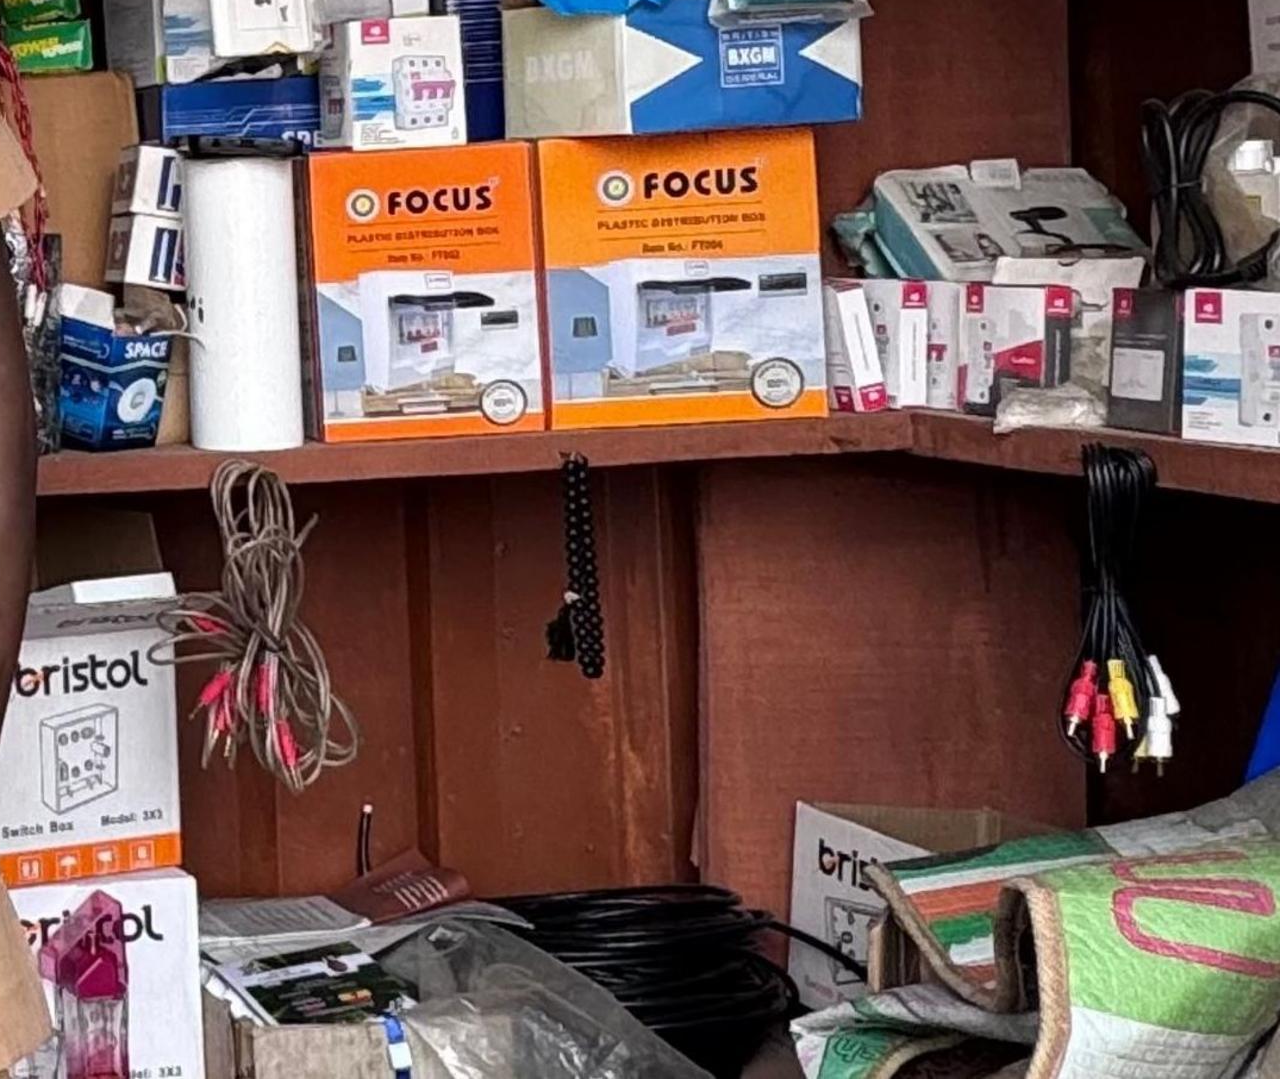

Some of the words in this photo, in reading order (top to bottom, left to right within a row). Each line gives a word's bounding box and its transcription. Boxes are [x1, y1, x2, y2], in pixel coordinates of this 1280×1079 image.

[524, 48, 595, 81] BXGM
[726, 45, 777, 67] BXGM
[643, 166, 760, 199] FOCUS
[386, 184, 493, 217] FOCUS
[123, 340, 170, 360] SPACE
[13, 649, 149, 698] bristol
[1, 823, 45, 840] Switch
[48, 819, 75, 834] Box
